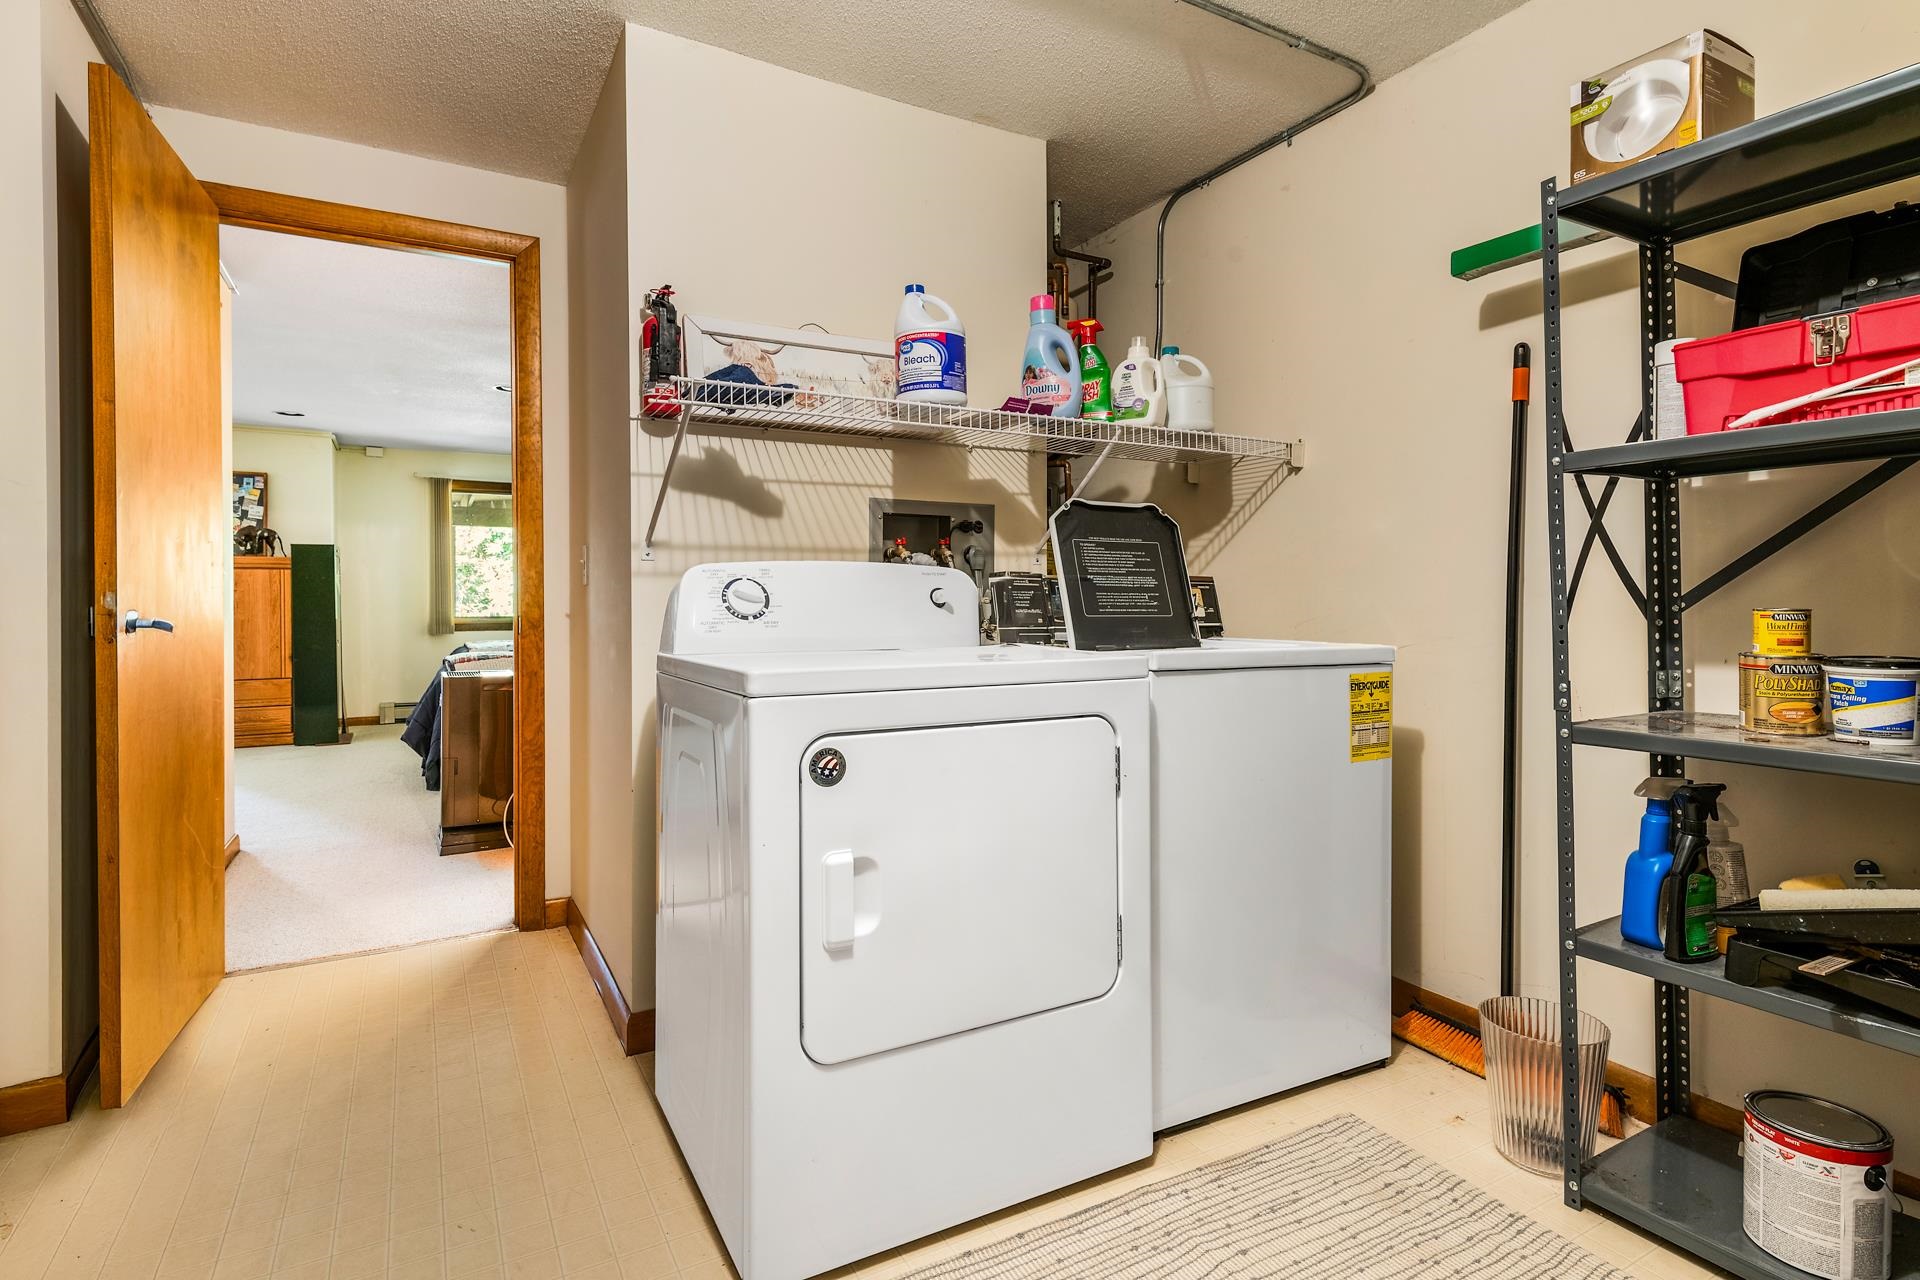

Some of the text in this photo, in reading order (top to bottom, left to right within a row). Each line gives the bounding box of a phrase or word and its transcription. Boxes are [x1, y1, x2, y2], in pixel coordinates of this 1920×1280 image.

[904, 354, 935, 366] Bleach
[1025, 384, 1060, 397] Downy
[1082, 389, 1099, 402] ASH
[1774, 613, 1806, 621] MINWAX
[1774, 664, 1819, 674] MINWAX
[1754, 674, 1821, 691] POLYSHAD
[1841, 694, 1867, 703] Ceiling
[811, 749, 838, 773] AMERICA
[1784, 1137, 1801, 1146] WHITE
